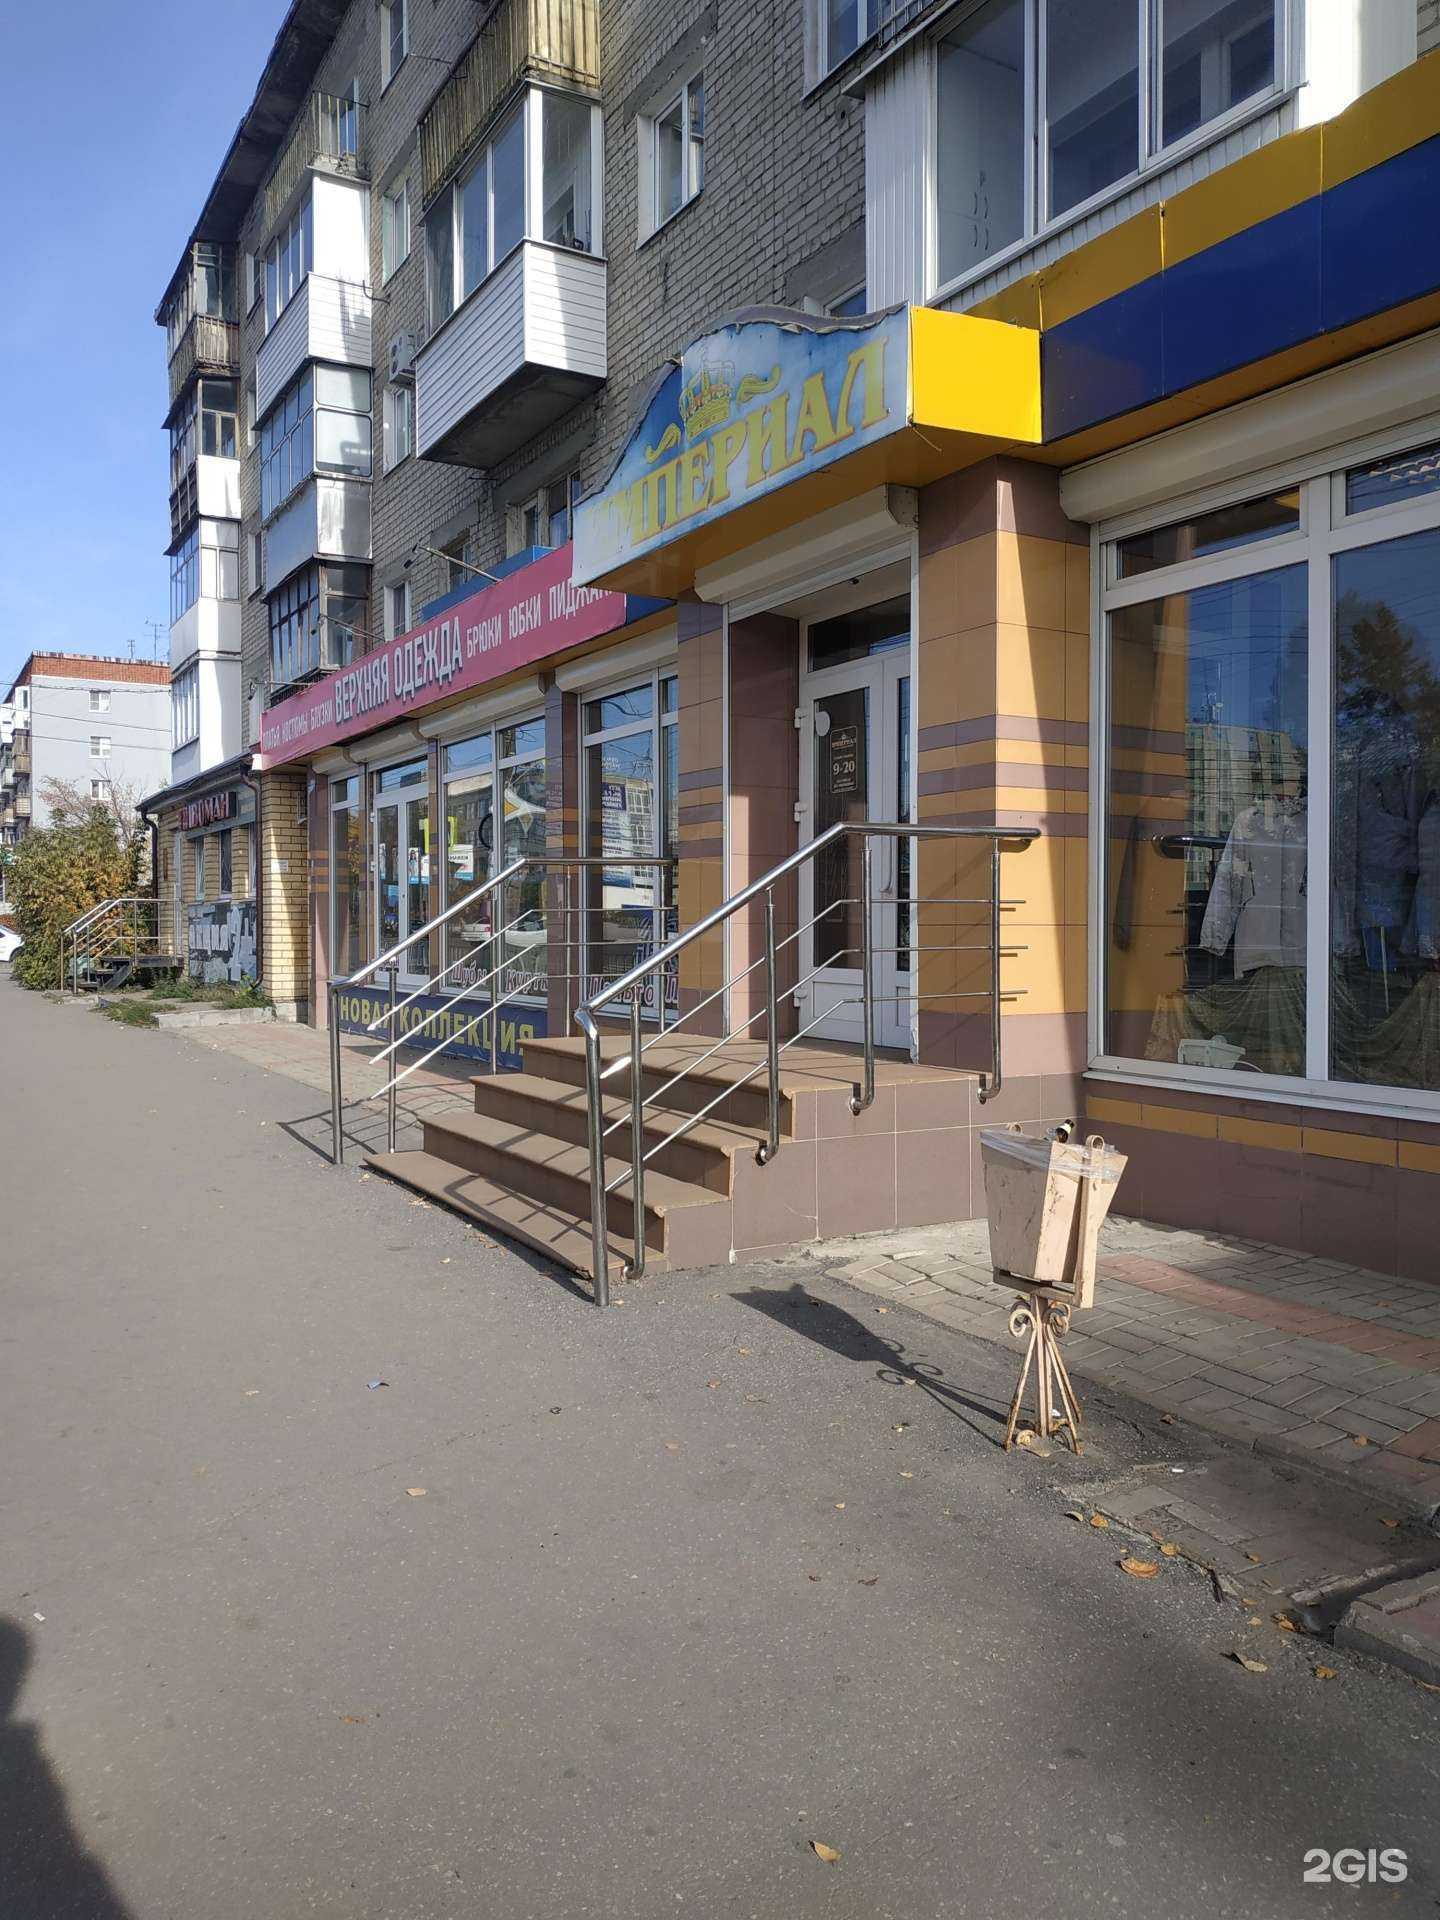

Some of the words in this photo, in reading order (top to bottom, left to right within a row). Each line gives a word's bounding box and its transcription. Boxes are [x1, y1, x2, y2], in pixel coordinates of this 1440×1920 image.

[582, 336, 889, 548] МПЕРИАЛ
[334, 654, 390, 722] ВЕРХНЯЯ
[393, 616, 463, 702] ОДЕЖДА
[466, 613, 502, 658] БРЮКИ
[508, 593, 542, 640] ЮБКИ
[549, 579, 612, 621] ПИДЖ
[400, 1007, 534, 1056] КОЛЛЕКЦИЯ
[590, 975, 654, 1006] Паьто
